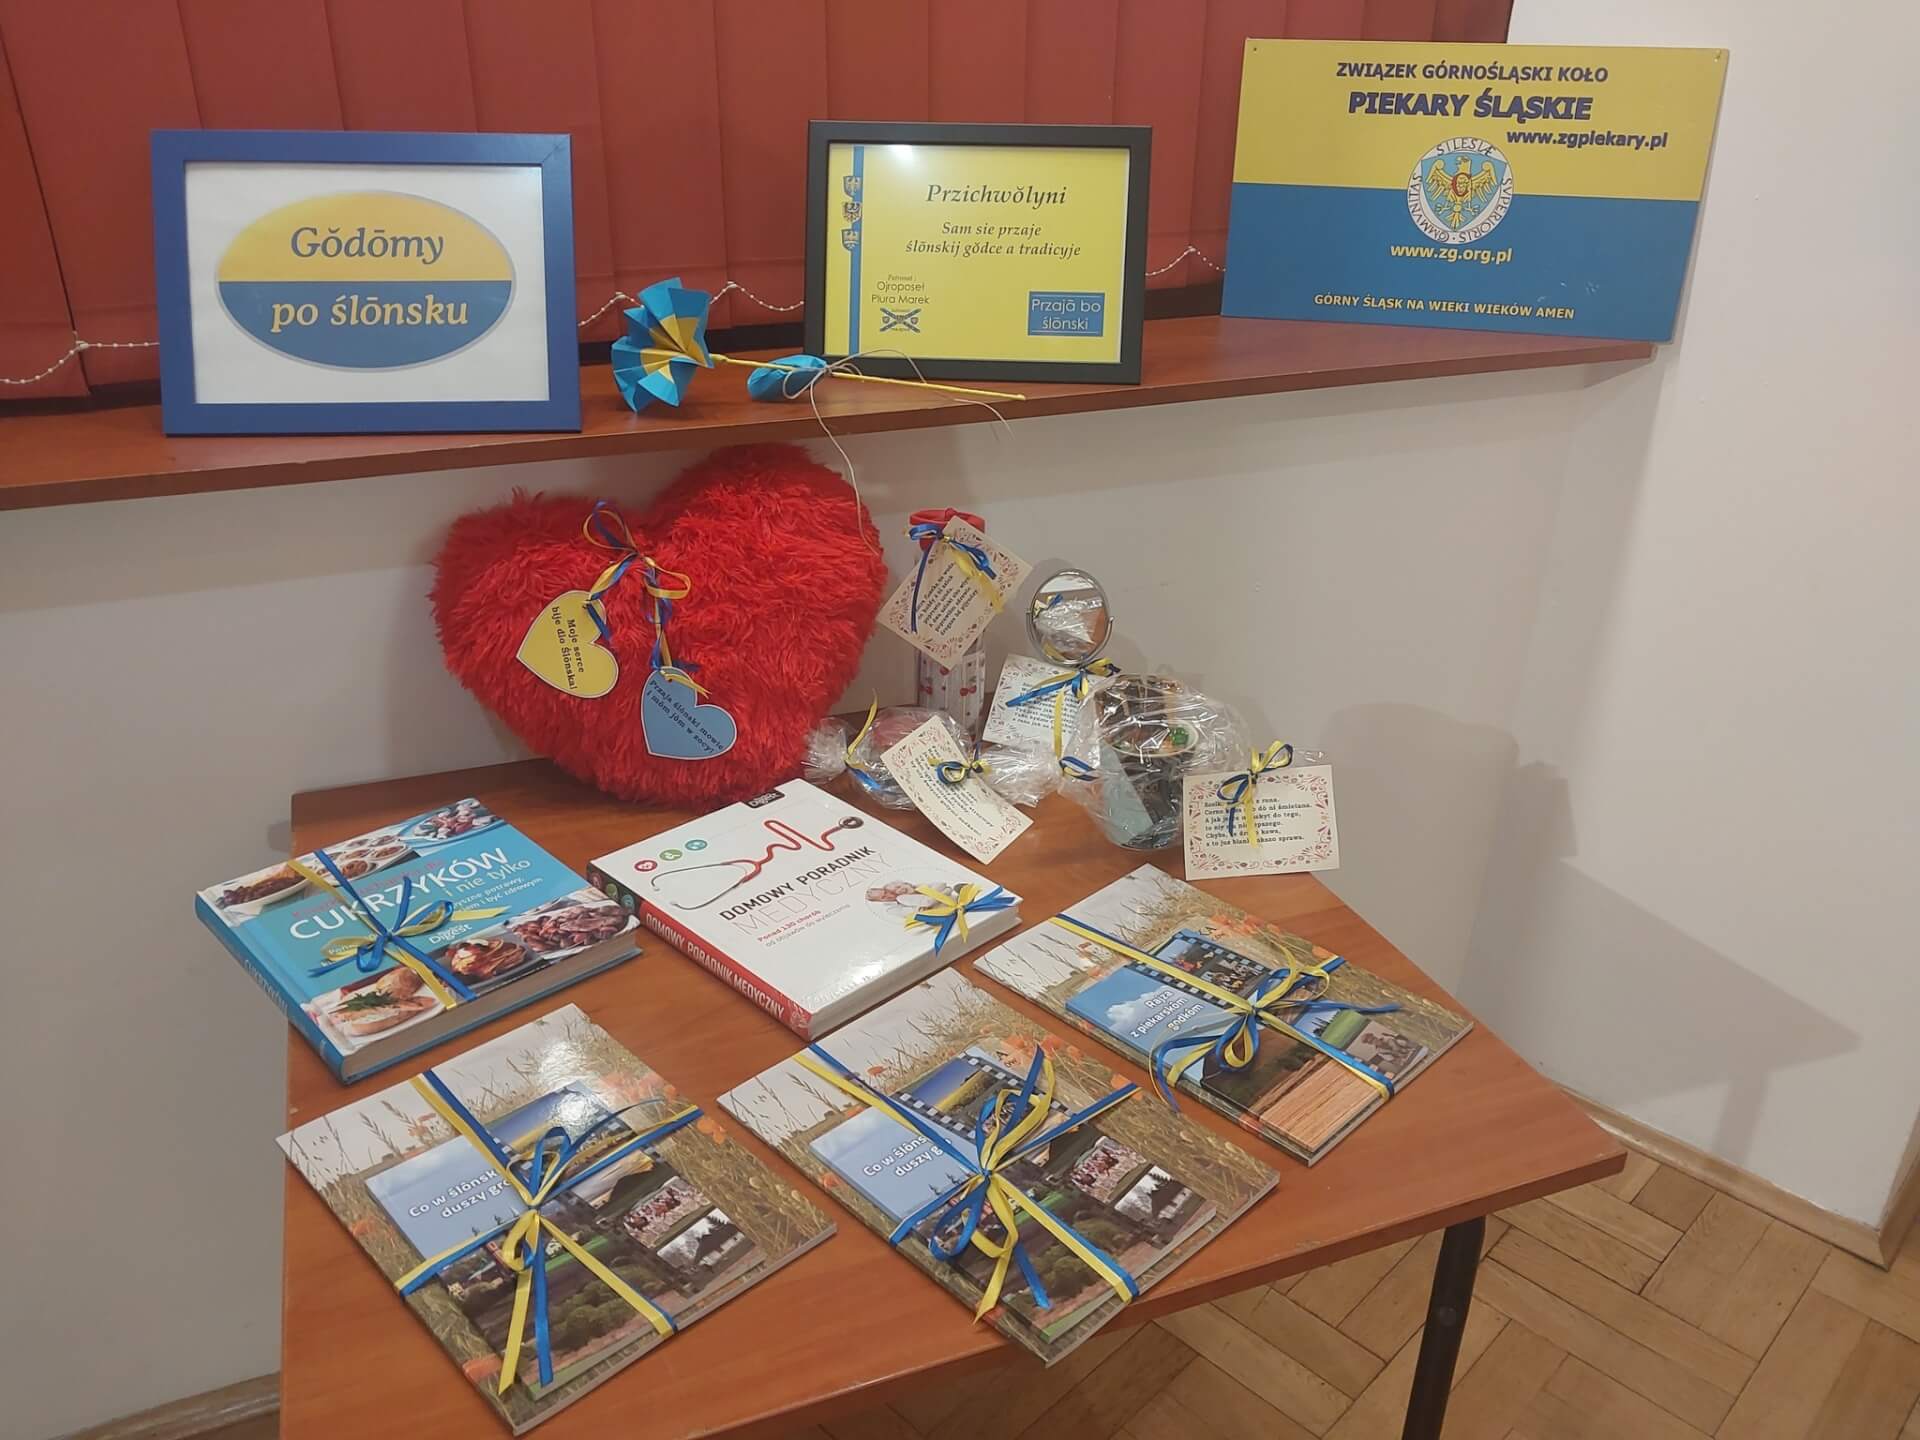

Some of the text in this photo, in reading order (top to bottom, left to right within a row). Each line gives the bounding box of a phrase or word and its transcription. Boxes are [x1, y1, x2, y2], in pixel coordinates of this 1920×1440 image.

[1336, 59, 1608, 84] ZWIĄZEK GÓRNOŚLĄSKI KOŁO
[1349, 88, 1594, 124] PIEKARY ŚLĄSKIE
[1506, 130, 1668, 150] www.zgpiekary.pl
[941, 221, 1042, 240] Sam sie przaje
[1006, 246, 1014, 256] a
[1018, 243, 1081, 259] tradicyje
[1390, 243, 1512, 264] www.zg.org.pl
[898, 295, 930, 304] Marek
[1314, 292, 1575, 320] GÓRNY ŚLĄSK NA WIEKI WIEKÓW AMEN
[270, 303, 319, 333] po
[567, 618, 584, 673] Moje serce
[456, 877, 485, 892] nie
[487, 860, 531, 880] tylko
[719, 846, 875, 921] DOMOWY PORADNIK
[289, 847, 510, 939] CUKRZYKÓW
[733, 853, 892, 935] MEDYCZNY
[428, 923, 473, 944] Digest
[645, 913, 785, 1019] DOMOWY PORADNIK MEDYCZNY
[1144, 990, 1173, 1009] Rajza
[1130, 1030, 1140, 1038] z
[863, 1164, 882, 1176] Co
[881, 1155, 894, 1166] w
[895, 1151, 933, 1177] duszy
[408, 1204, 430, 1217] Co
[431, 1195, 446, 1207] w
[441, 1191, 487, 1218] duszy
